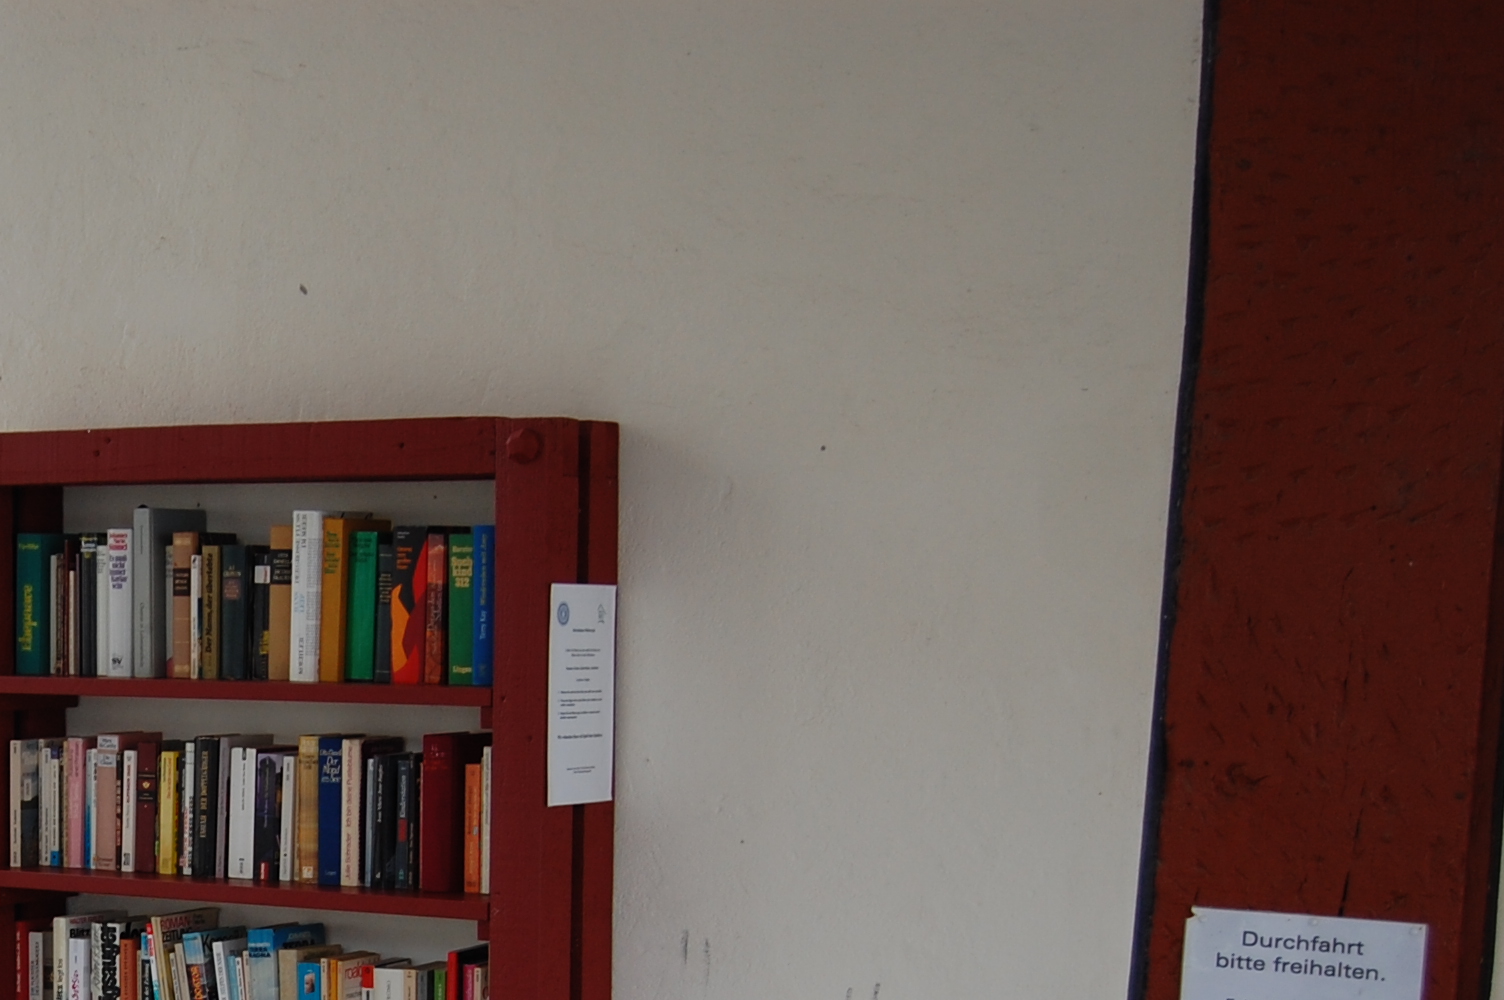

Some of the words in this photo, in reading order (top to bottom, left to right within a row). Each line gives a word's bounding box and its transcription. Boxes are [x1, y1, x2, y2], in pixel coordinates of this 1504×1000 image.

[1241, 930, 1365, 957] Durchfahrt
[1215, 952, 1266, 972] bitte
[1272, 956, 1386, 982] freihalten.
